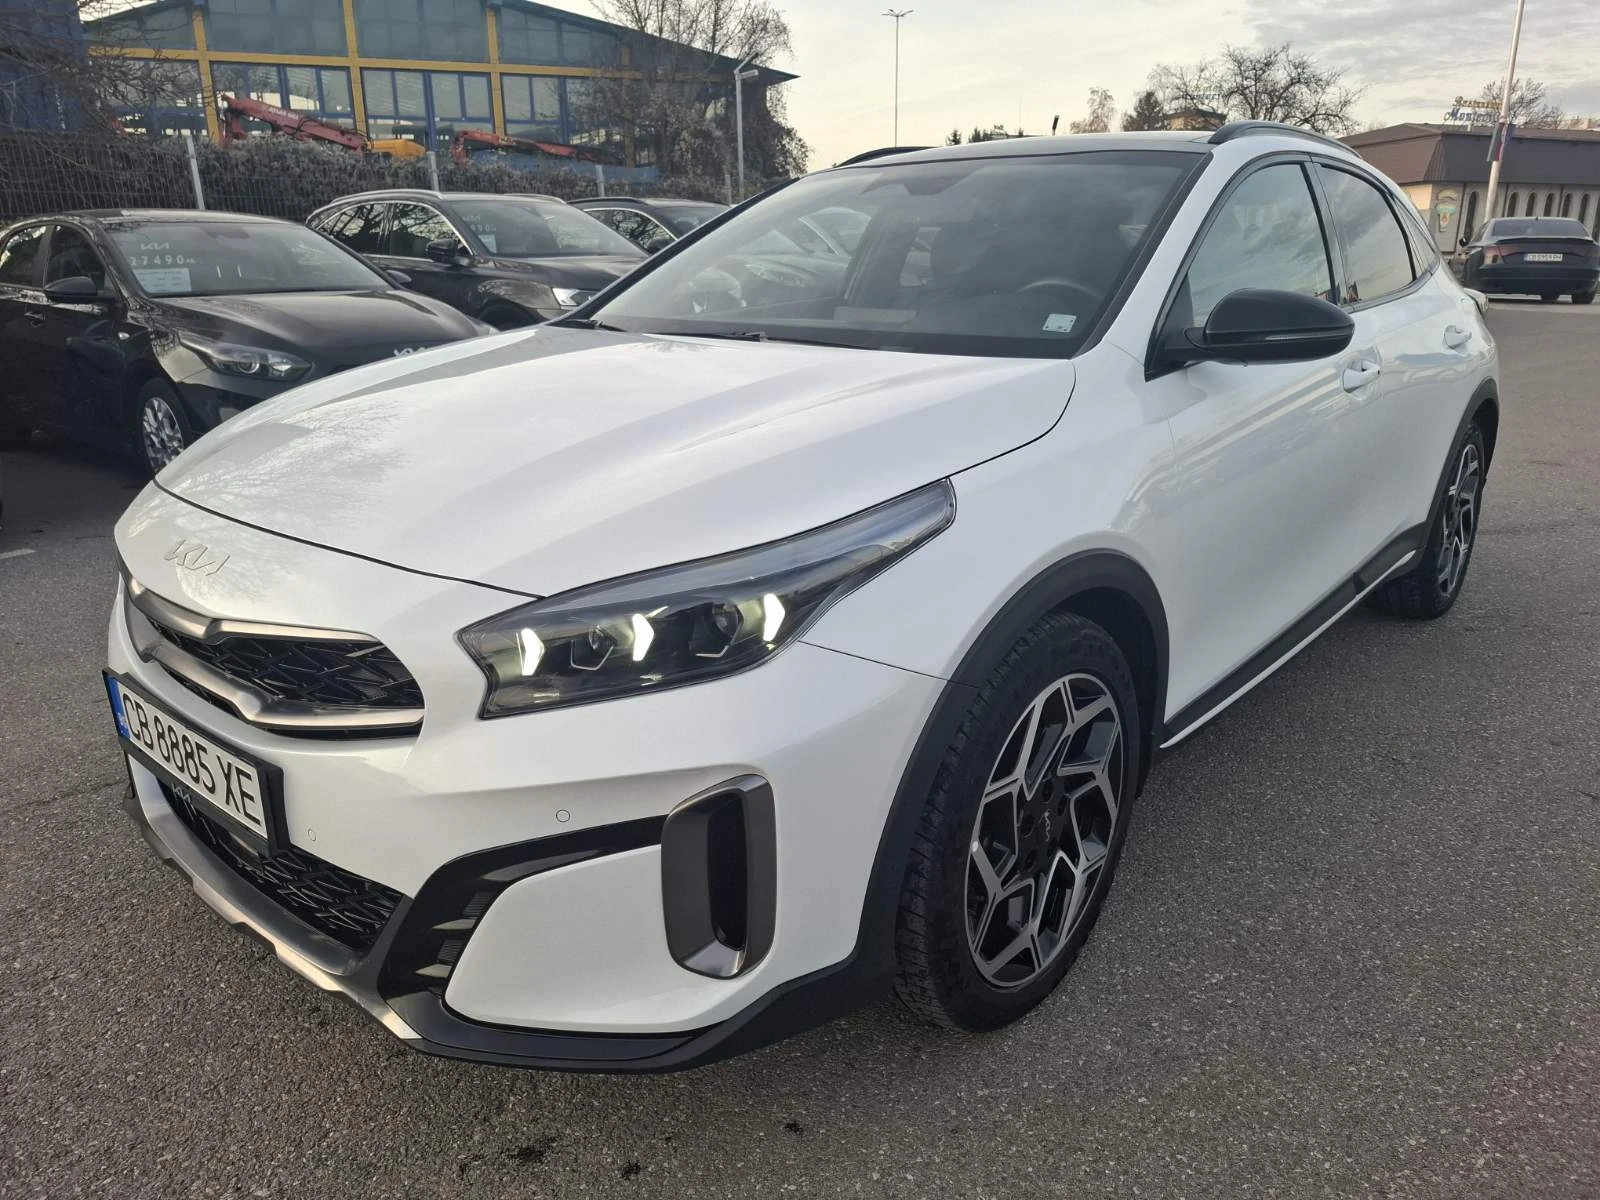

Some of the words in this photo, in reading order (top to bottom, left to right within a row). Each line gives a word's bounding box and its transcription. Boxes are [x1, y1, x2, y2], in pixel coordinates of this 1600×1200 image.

[163, 538, 231, 577] KIA
[121, 692, 155, 751] CB
[153, 714, 216, 796] 8885
[216, 754, 262, 827] XE
